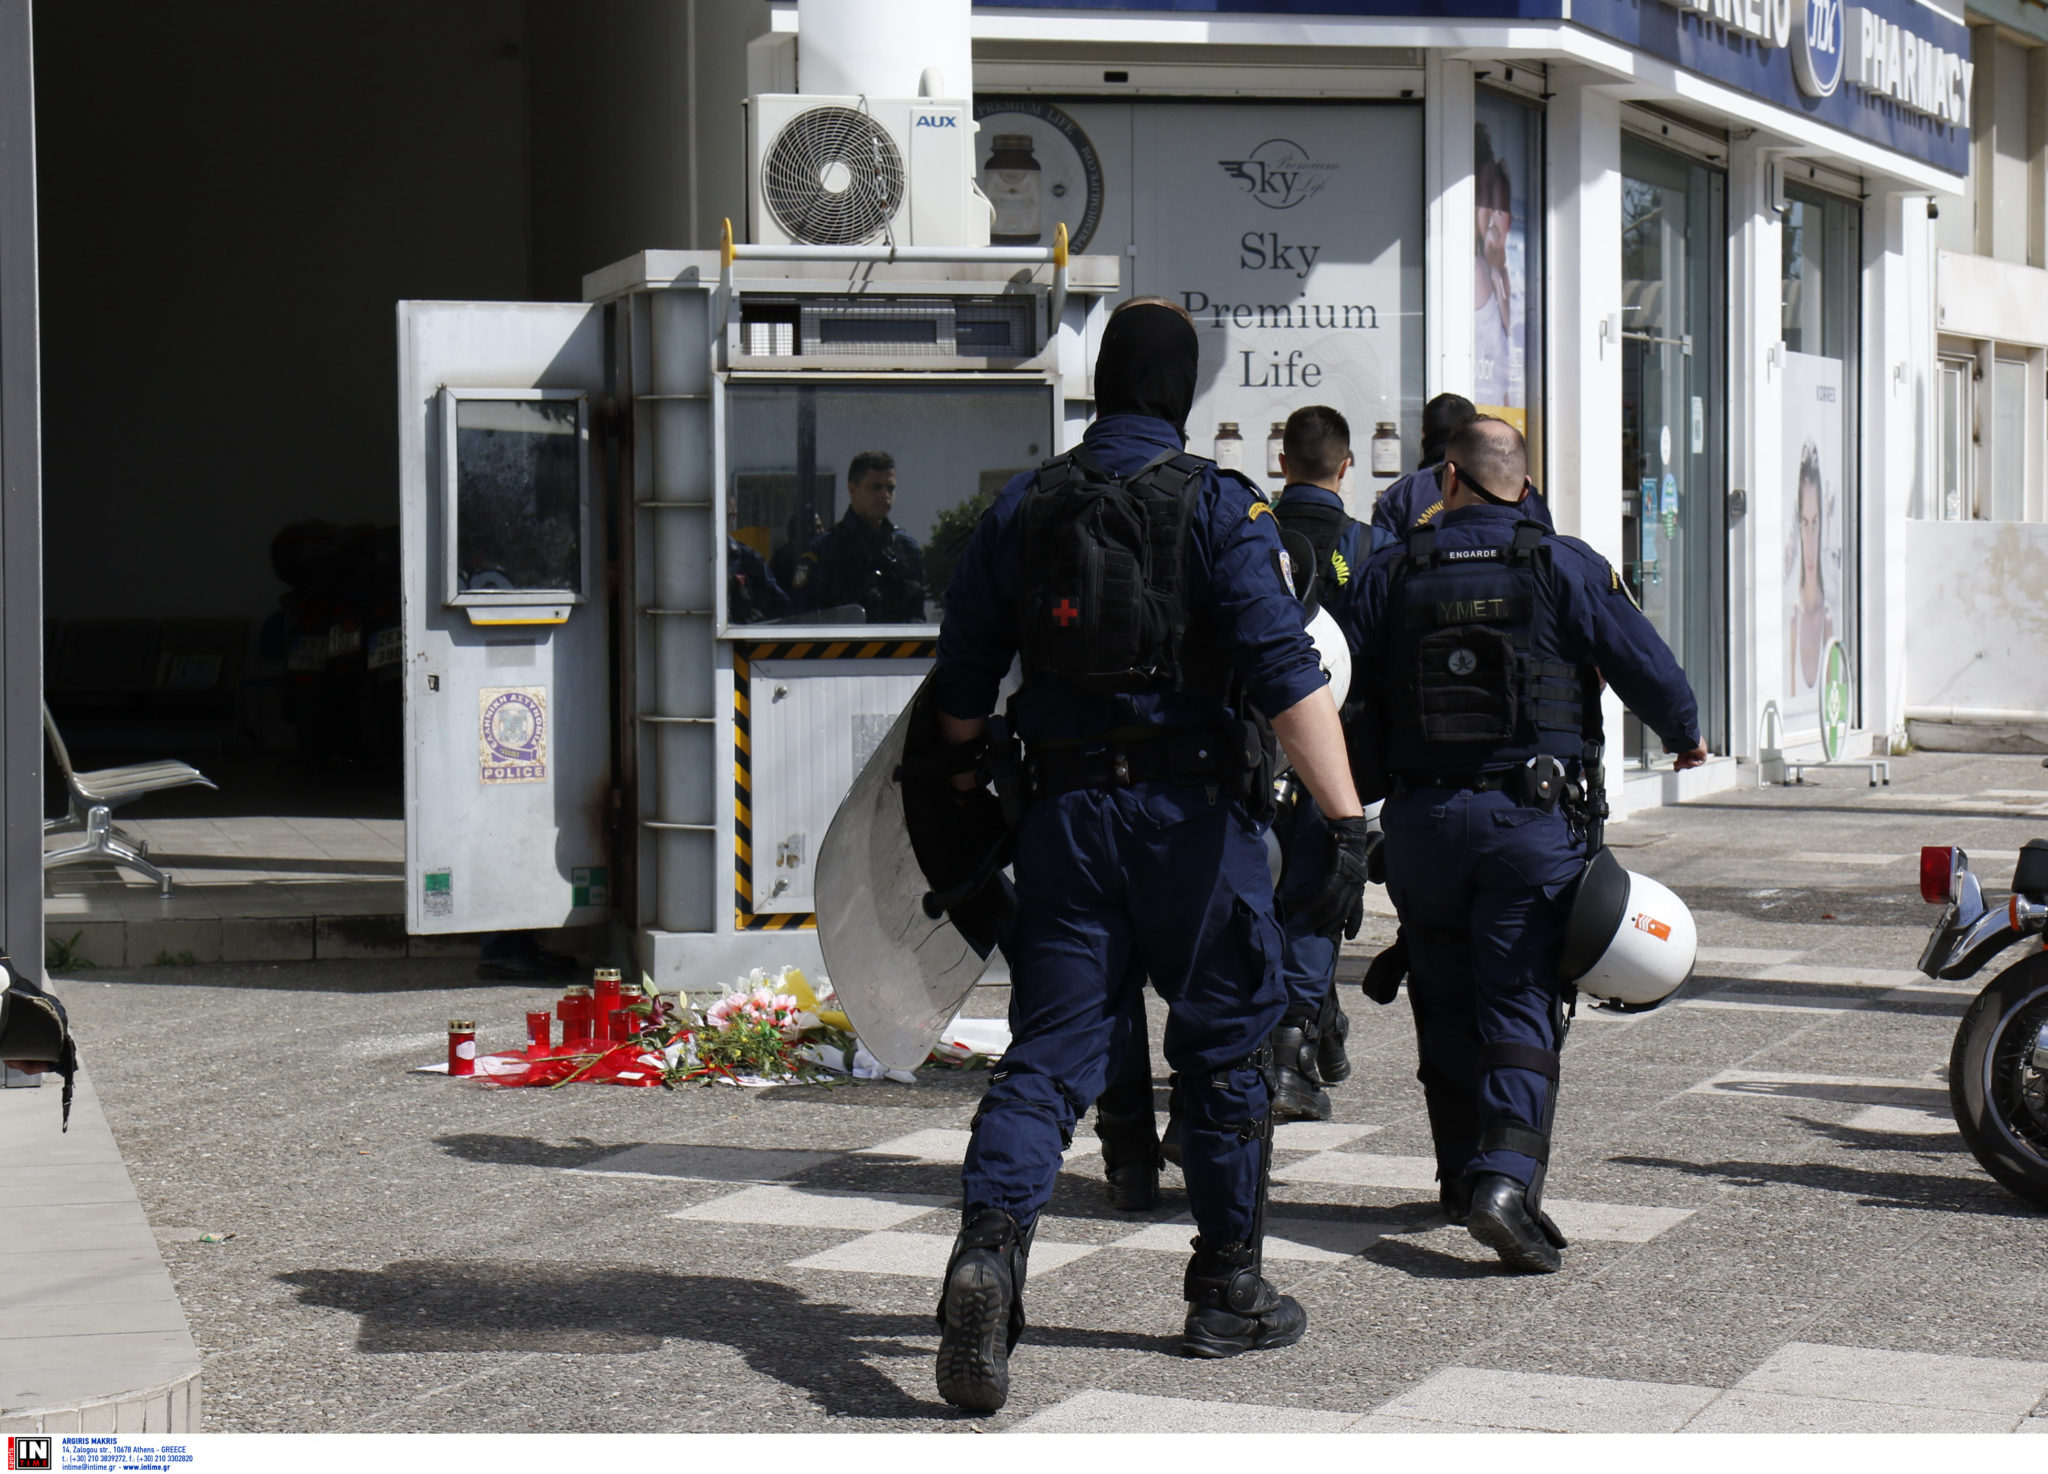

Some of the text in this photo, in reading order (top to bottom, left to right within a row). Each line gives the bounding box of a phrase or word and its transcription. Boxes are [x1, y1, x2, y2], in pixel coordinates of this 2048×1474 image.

[1860, 7, 1975, 128] PHARMACY
[916, 115, 957, 128] AUX
[976, 101, 1074, 134] PREMIUM LIFE
[1231, 161, 1299, 203] Sky
[1240, 231, 1321, 277] Sky
[1180, 290, 1379, 329] Premium
[1238, 350, 1323, 388] Life
[1449, 550, 1497, 559] ENGARDE
[484, 767, 544, 778] POLICE
